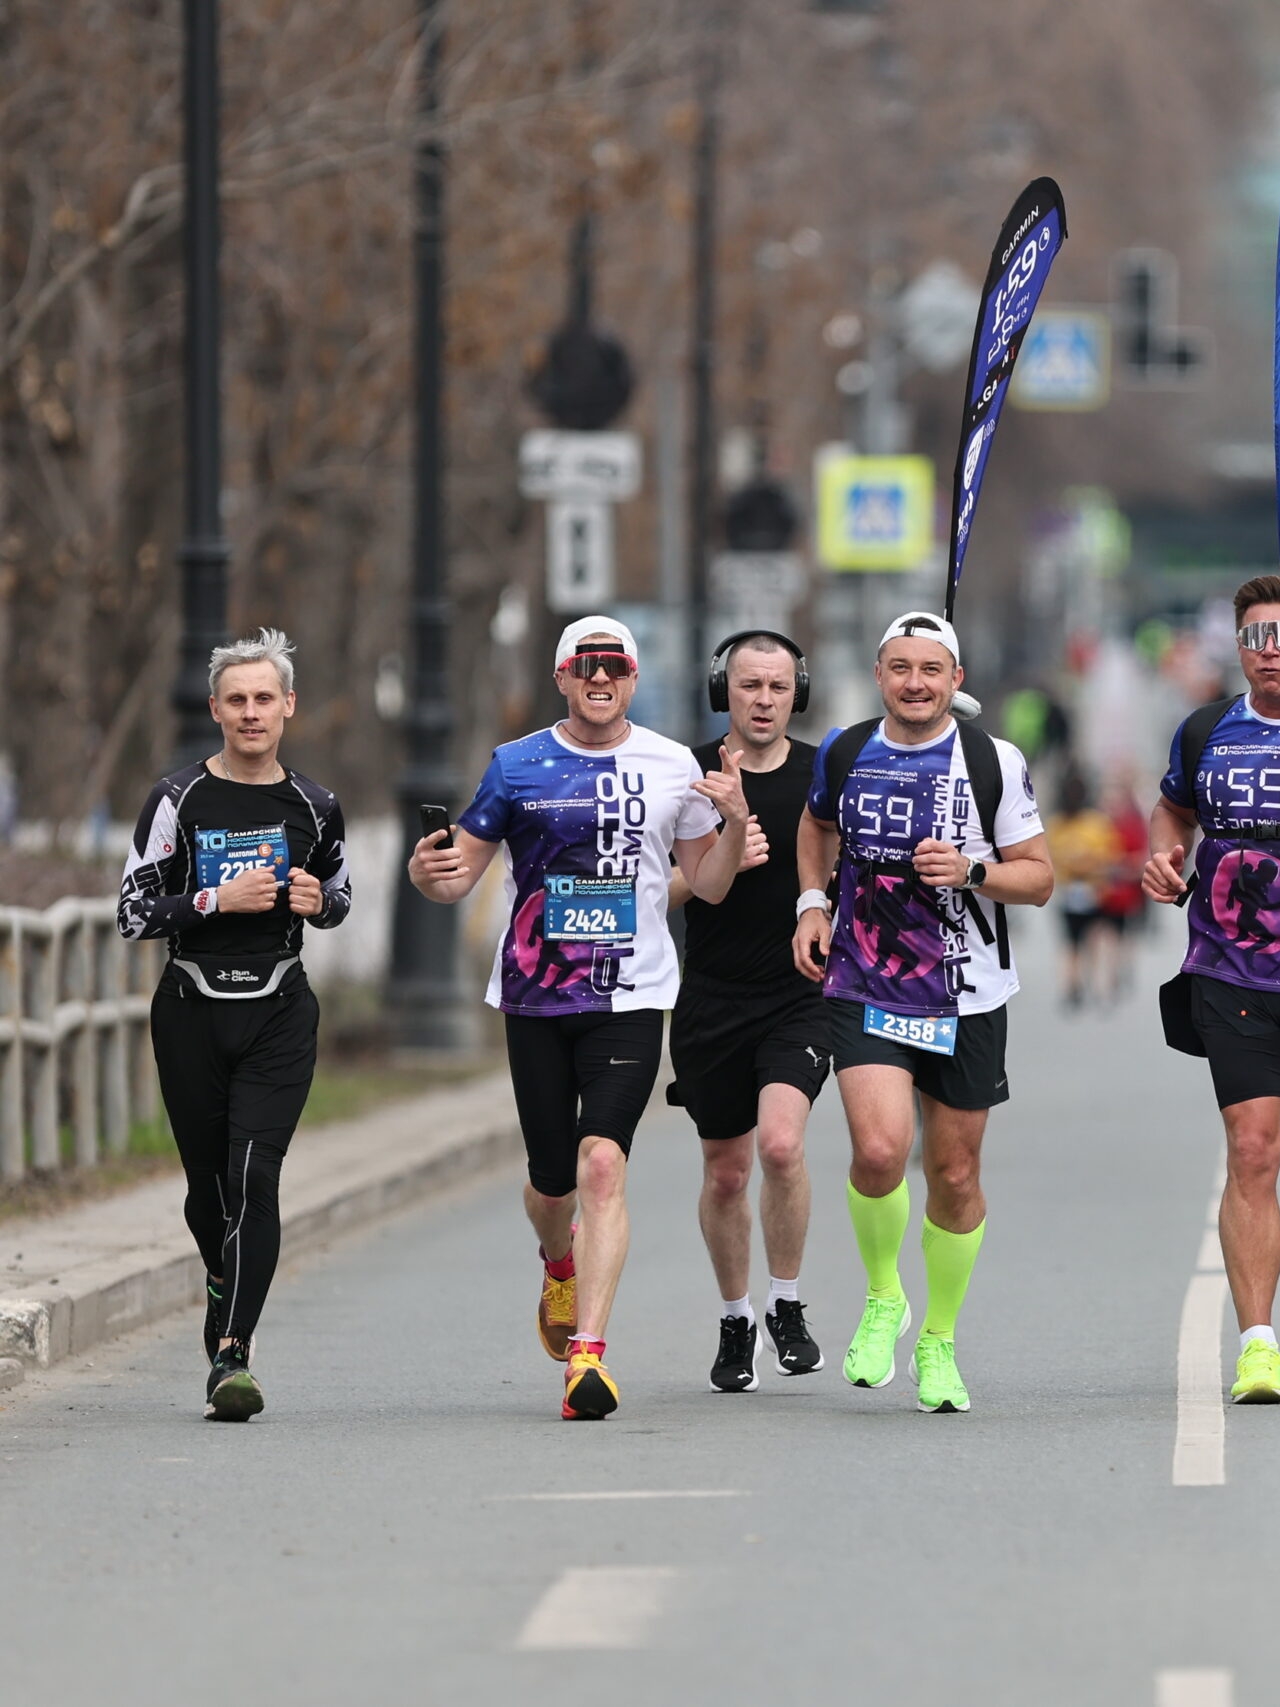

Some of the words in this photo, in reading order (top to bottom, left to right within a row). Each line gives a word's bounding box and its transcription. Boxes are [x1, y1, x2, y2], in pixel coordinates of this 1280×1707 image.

[1002, 205, 1039, 265] GARMIN
[1213, 746, 1228, 756] 10
[522, 801, 537, 811] 10
[227, 827, 282, 838] САМАРСКИЙ
[228, 849, 258, 858] АНАТОЛИЙ
[575, 877, 632, 885] САМАРСКИЙ
[563, 908, 617, 932] 2424
[882, 1014, 936, 1043] 2358
